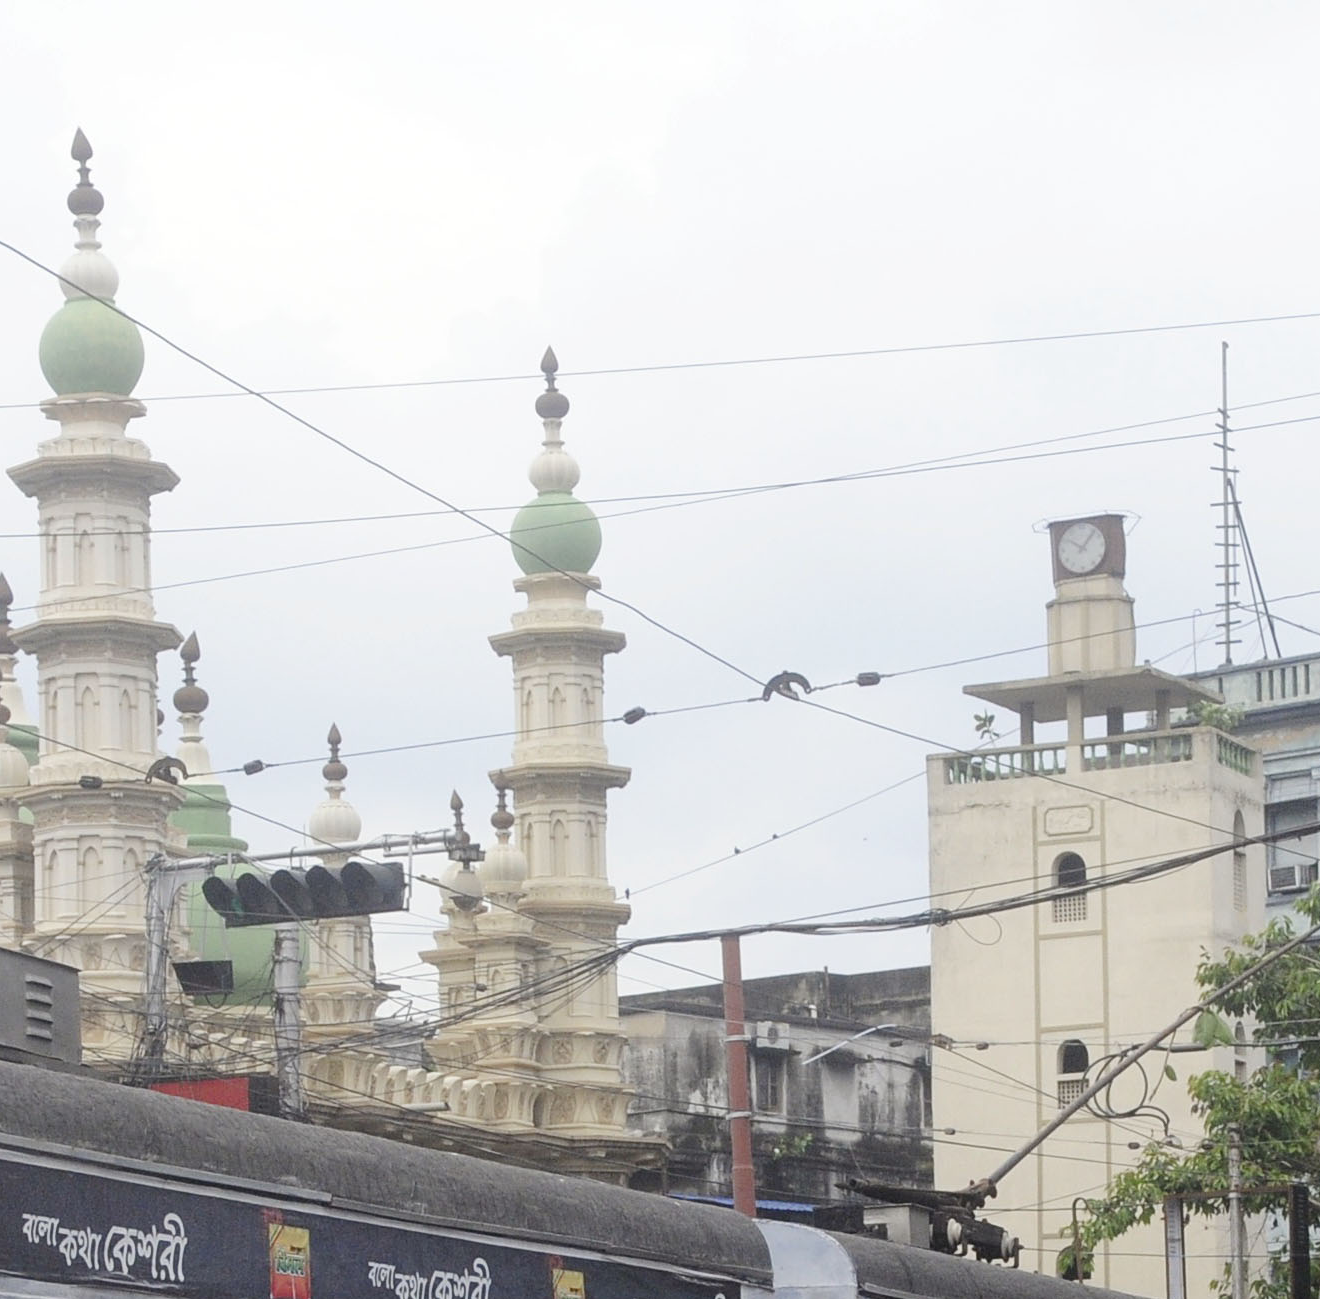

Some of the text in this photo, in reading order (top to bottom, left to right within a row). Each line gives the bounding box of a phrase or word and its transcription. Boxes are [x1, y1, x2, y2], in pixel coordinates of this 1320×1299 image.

[22, 1212, 188, 1282] বলো কথা কেশরী
